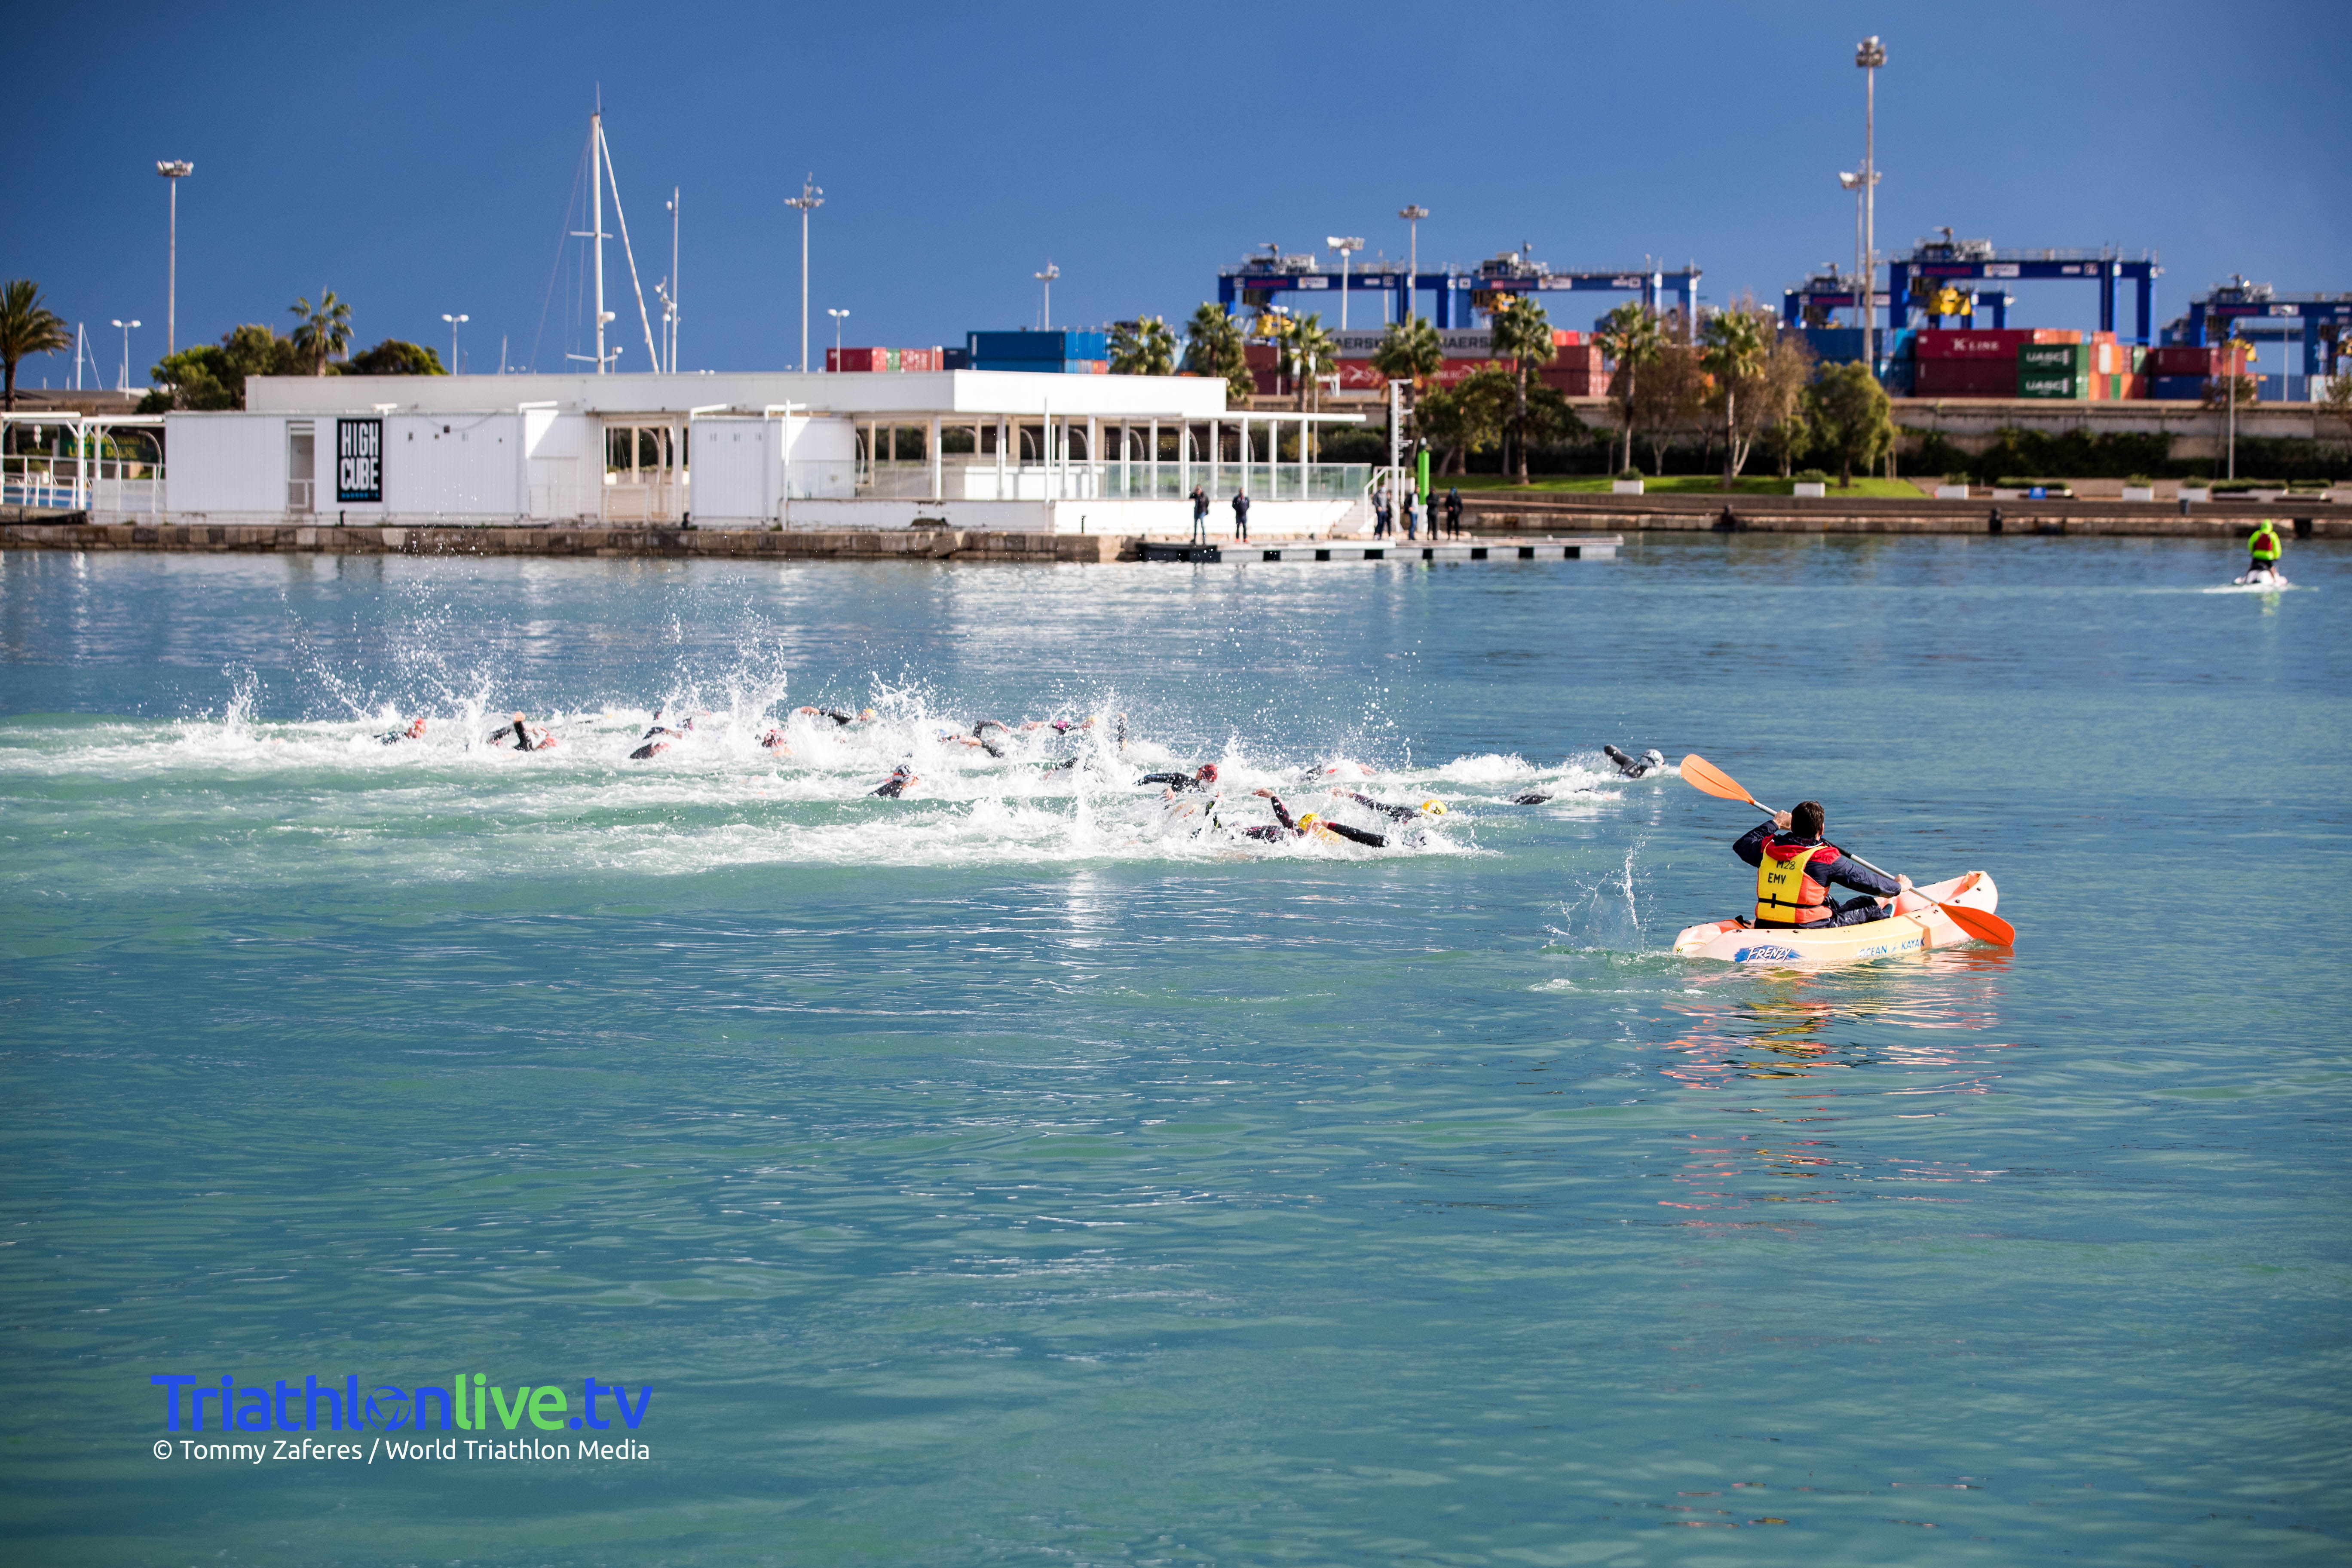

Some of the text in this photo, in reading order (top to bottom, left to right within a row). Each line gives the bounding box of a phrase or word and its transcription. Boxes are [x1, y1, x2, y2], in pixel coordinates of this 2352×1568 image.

[2026, 352, 2063, 362] UASC
[2025, 380, 2063, 391] UASC
[342, 422, 379, 457] HIGH
[341, 457, 379, 491] CUBE
[1776, 861, 1796, 870] M28
[1768, 873, 1786, 884] EMV
[1746, 944, 1792, 963] FRENZY
[1859, 937, 1925, 958] OCEAN KAYAK
